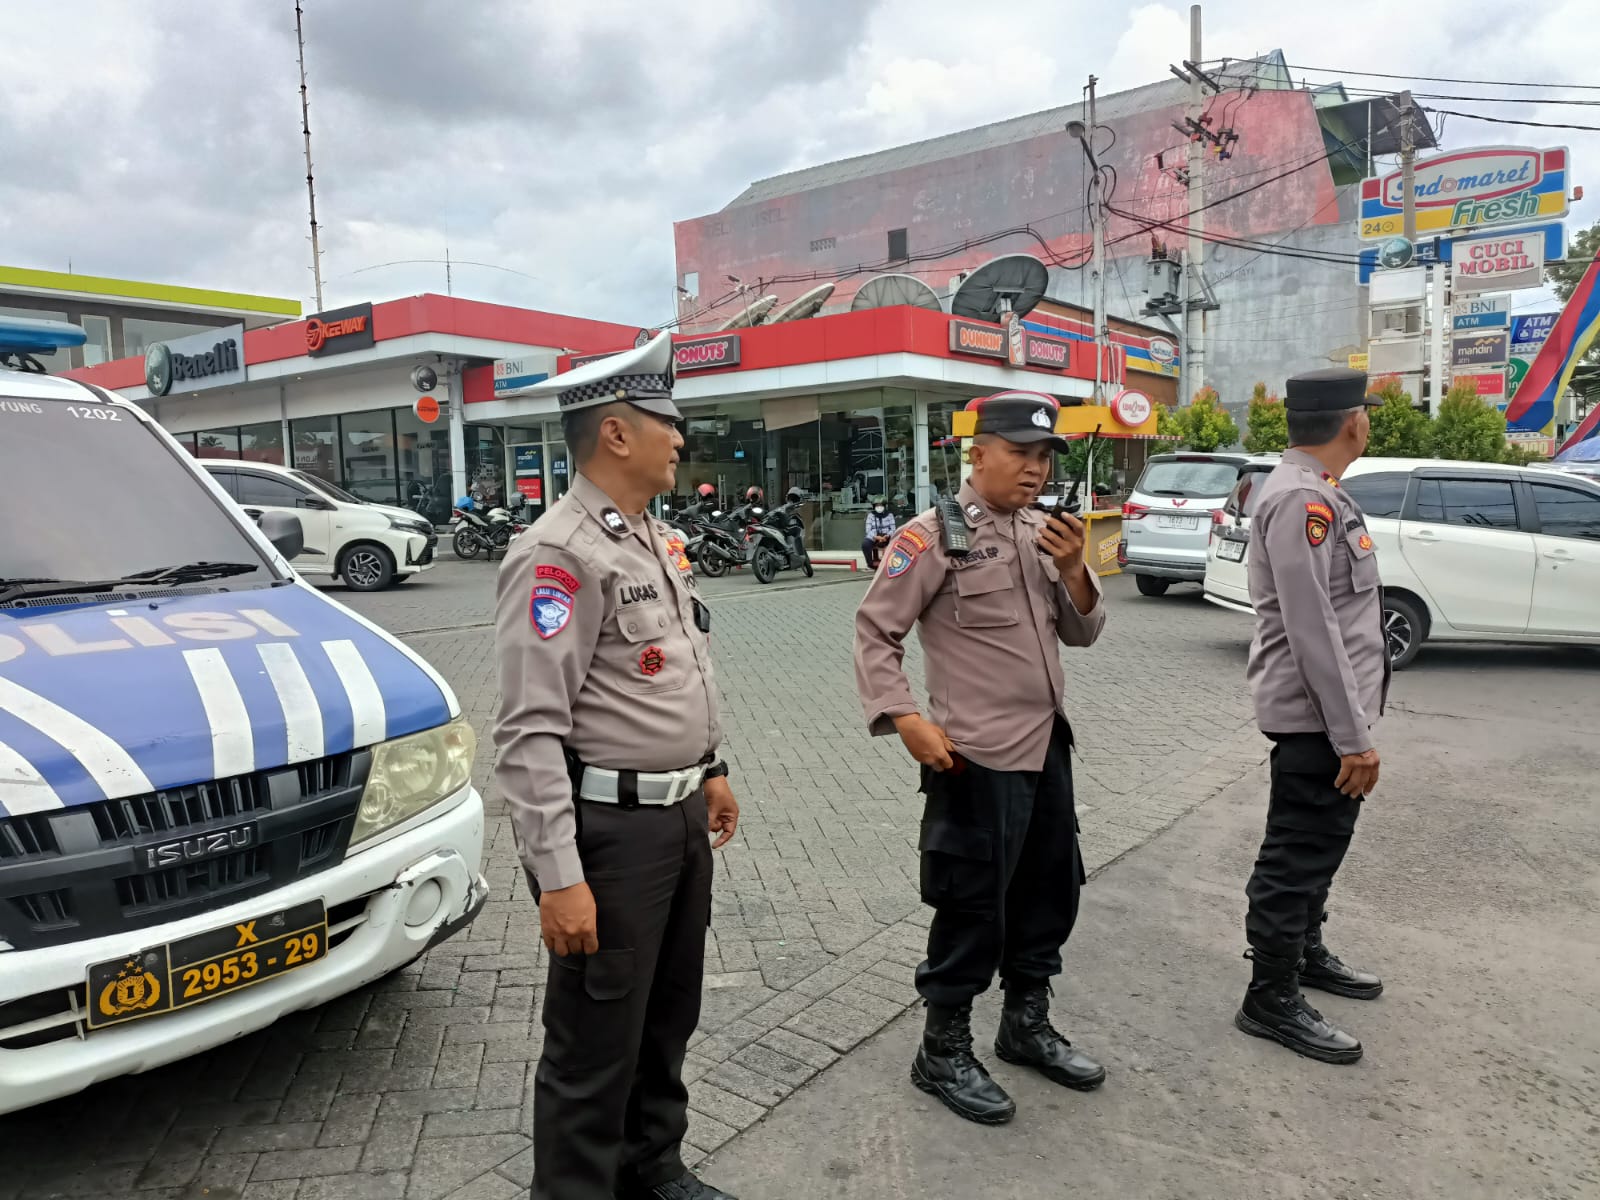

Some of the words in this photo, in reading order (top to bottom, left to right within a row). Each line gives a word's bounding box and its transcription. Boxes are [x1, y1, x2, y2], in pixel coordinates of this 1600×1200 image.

[1453, 189, 1540, 227] Fresh
[1364, 223, 1381, 235] 24
[1469, 239, 1524, 260] CUCI
[1459, 254, 1535, 276] MOBIL
[1470, 300, 1496, 313] BNI
[321, 316, 366, 339] KEEWAY
[1457, 317, 1479, 327] ATM
[1523, 315, 1552, 328] ATM
[1532, 327, 1551, 339] BC
[171, 338, 239, 381] Benelli
[1029, 340, 1067, 362] DONUTS
[1458, 345, 1493, 356] mandiri
[506, 360, 524, 375] BNI
[66, 406, 122, 421] 1202
[537, 566, 577, 589] PELOPOR
[146, 826, 251, 869] ISUZU
[235, 920, 259, 947] X
[182, 951, 259, 999] 2953
[284, 932, 319, 967] 29
